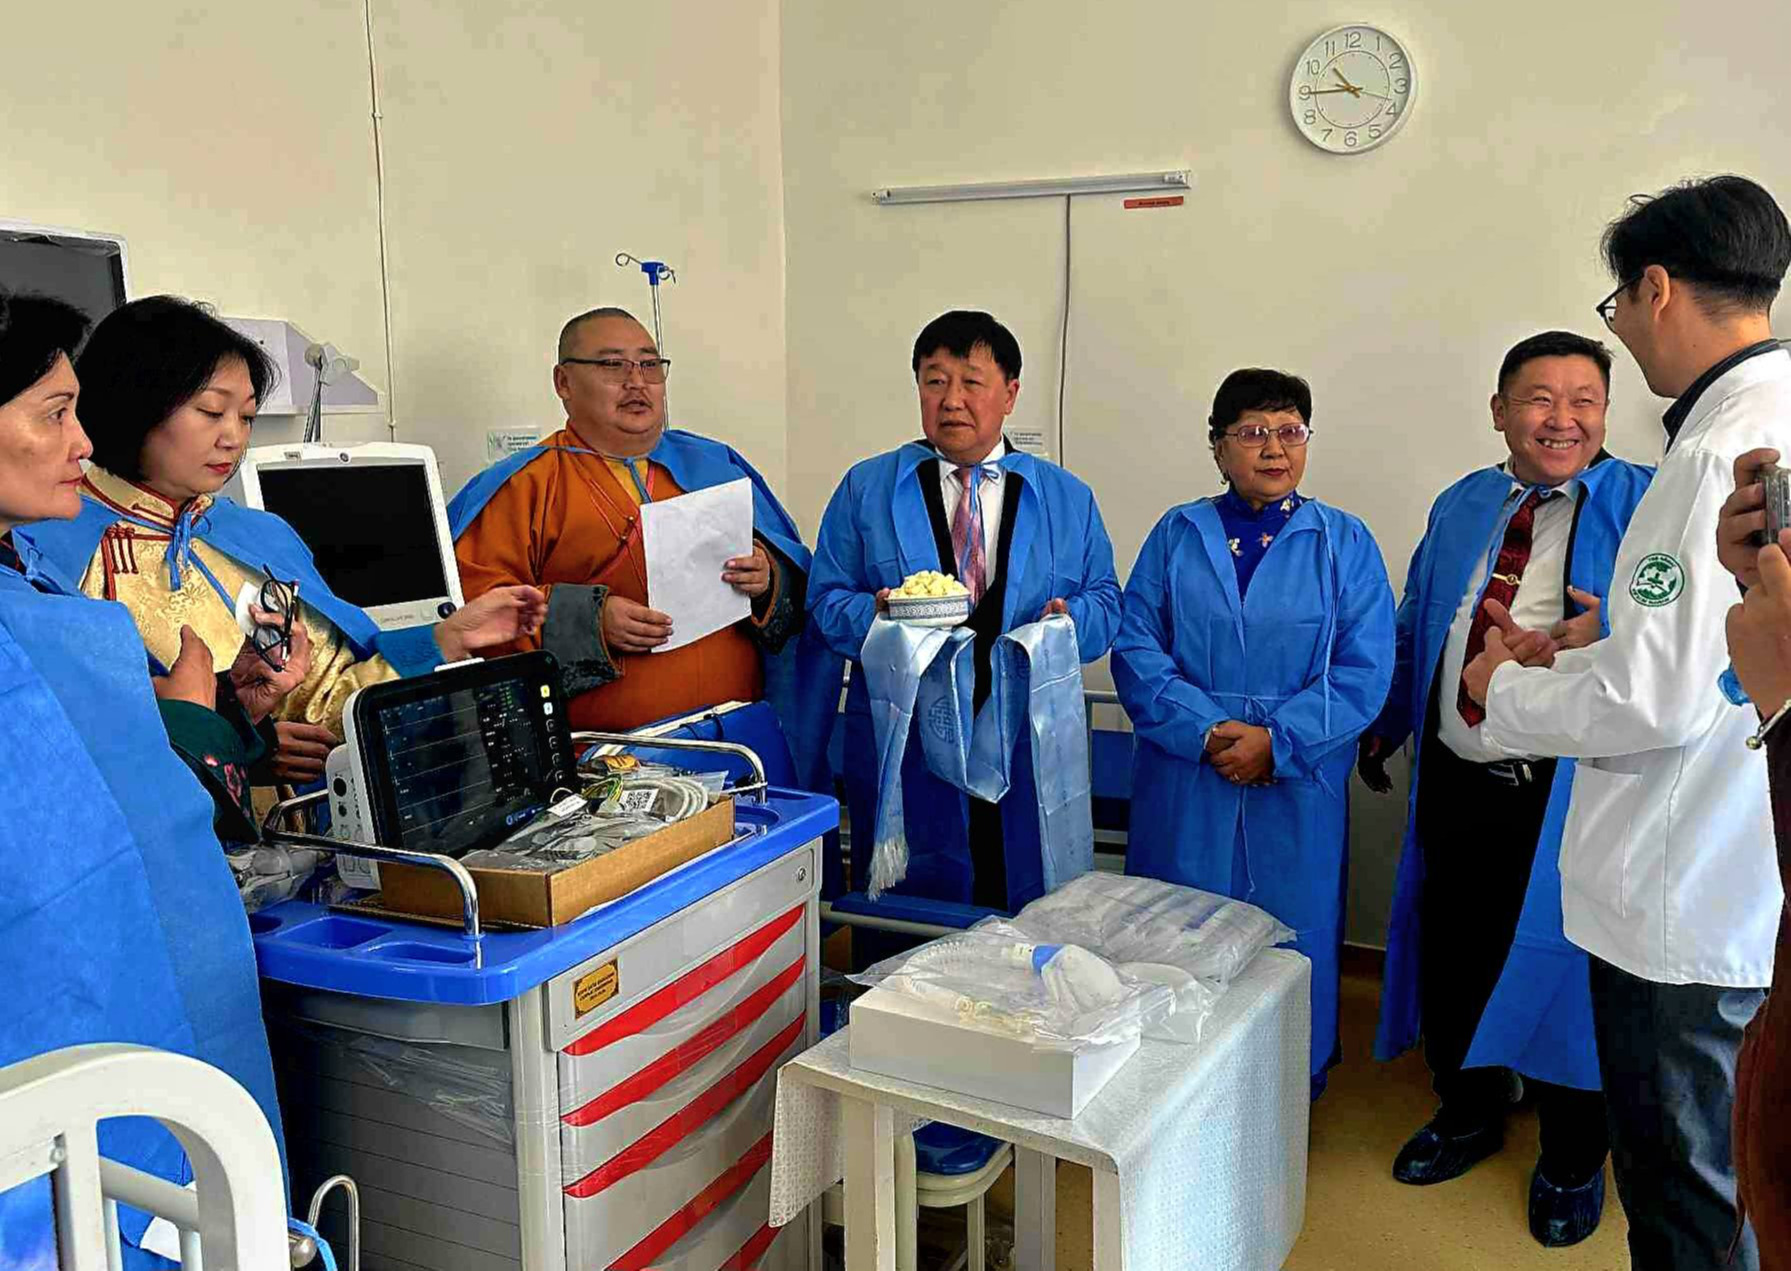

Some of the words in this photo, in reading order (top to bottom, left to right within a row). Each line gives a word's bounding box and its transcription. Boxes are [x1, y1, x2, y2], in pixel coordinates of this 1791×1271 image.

[1344, 31, 1361, 48] 12
[1376, 35, 1380, 51] 1
[1325, 40, 1335, 57] 11
[1306, 59, 1320, 76] 10
[1389, 52, 1403, 69] 2
[1298, 85, 1311, 101] 9
[1394, 77, 1408, 94] 3
[1303, 109, 1316, 125] 8
[1386, 102, 1397, 118] 4
[1321, 128, 1333, 142] 7
[1344, 131, 1357, 147] 6
[1368, 124, 1382, 139] 5
